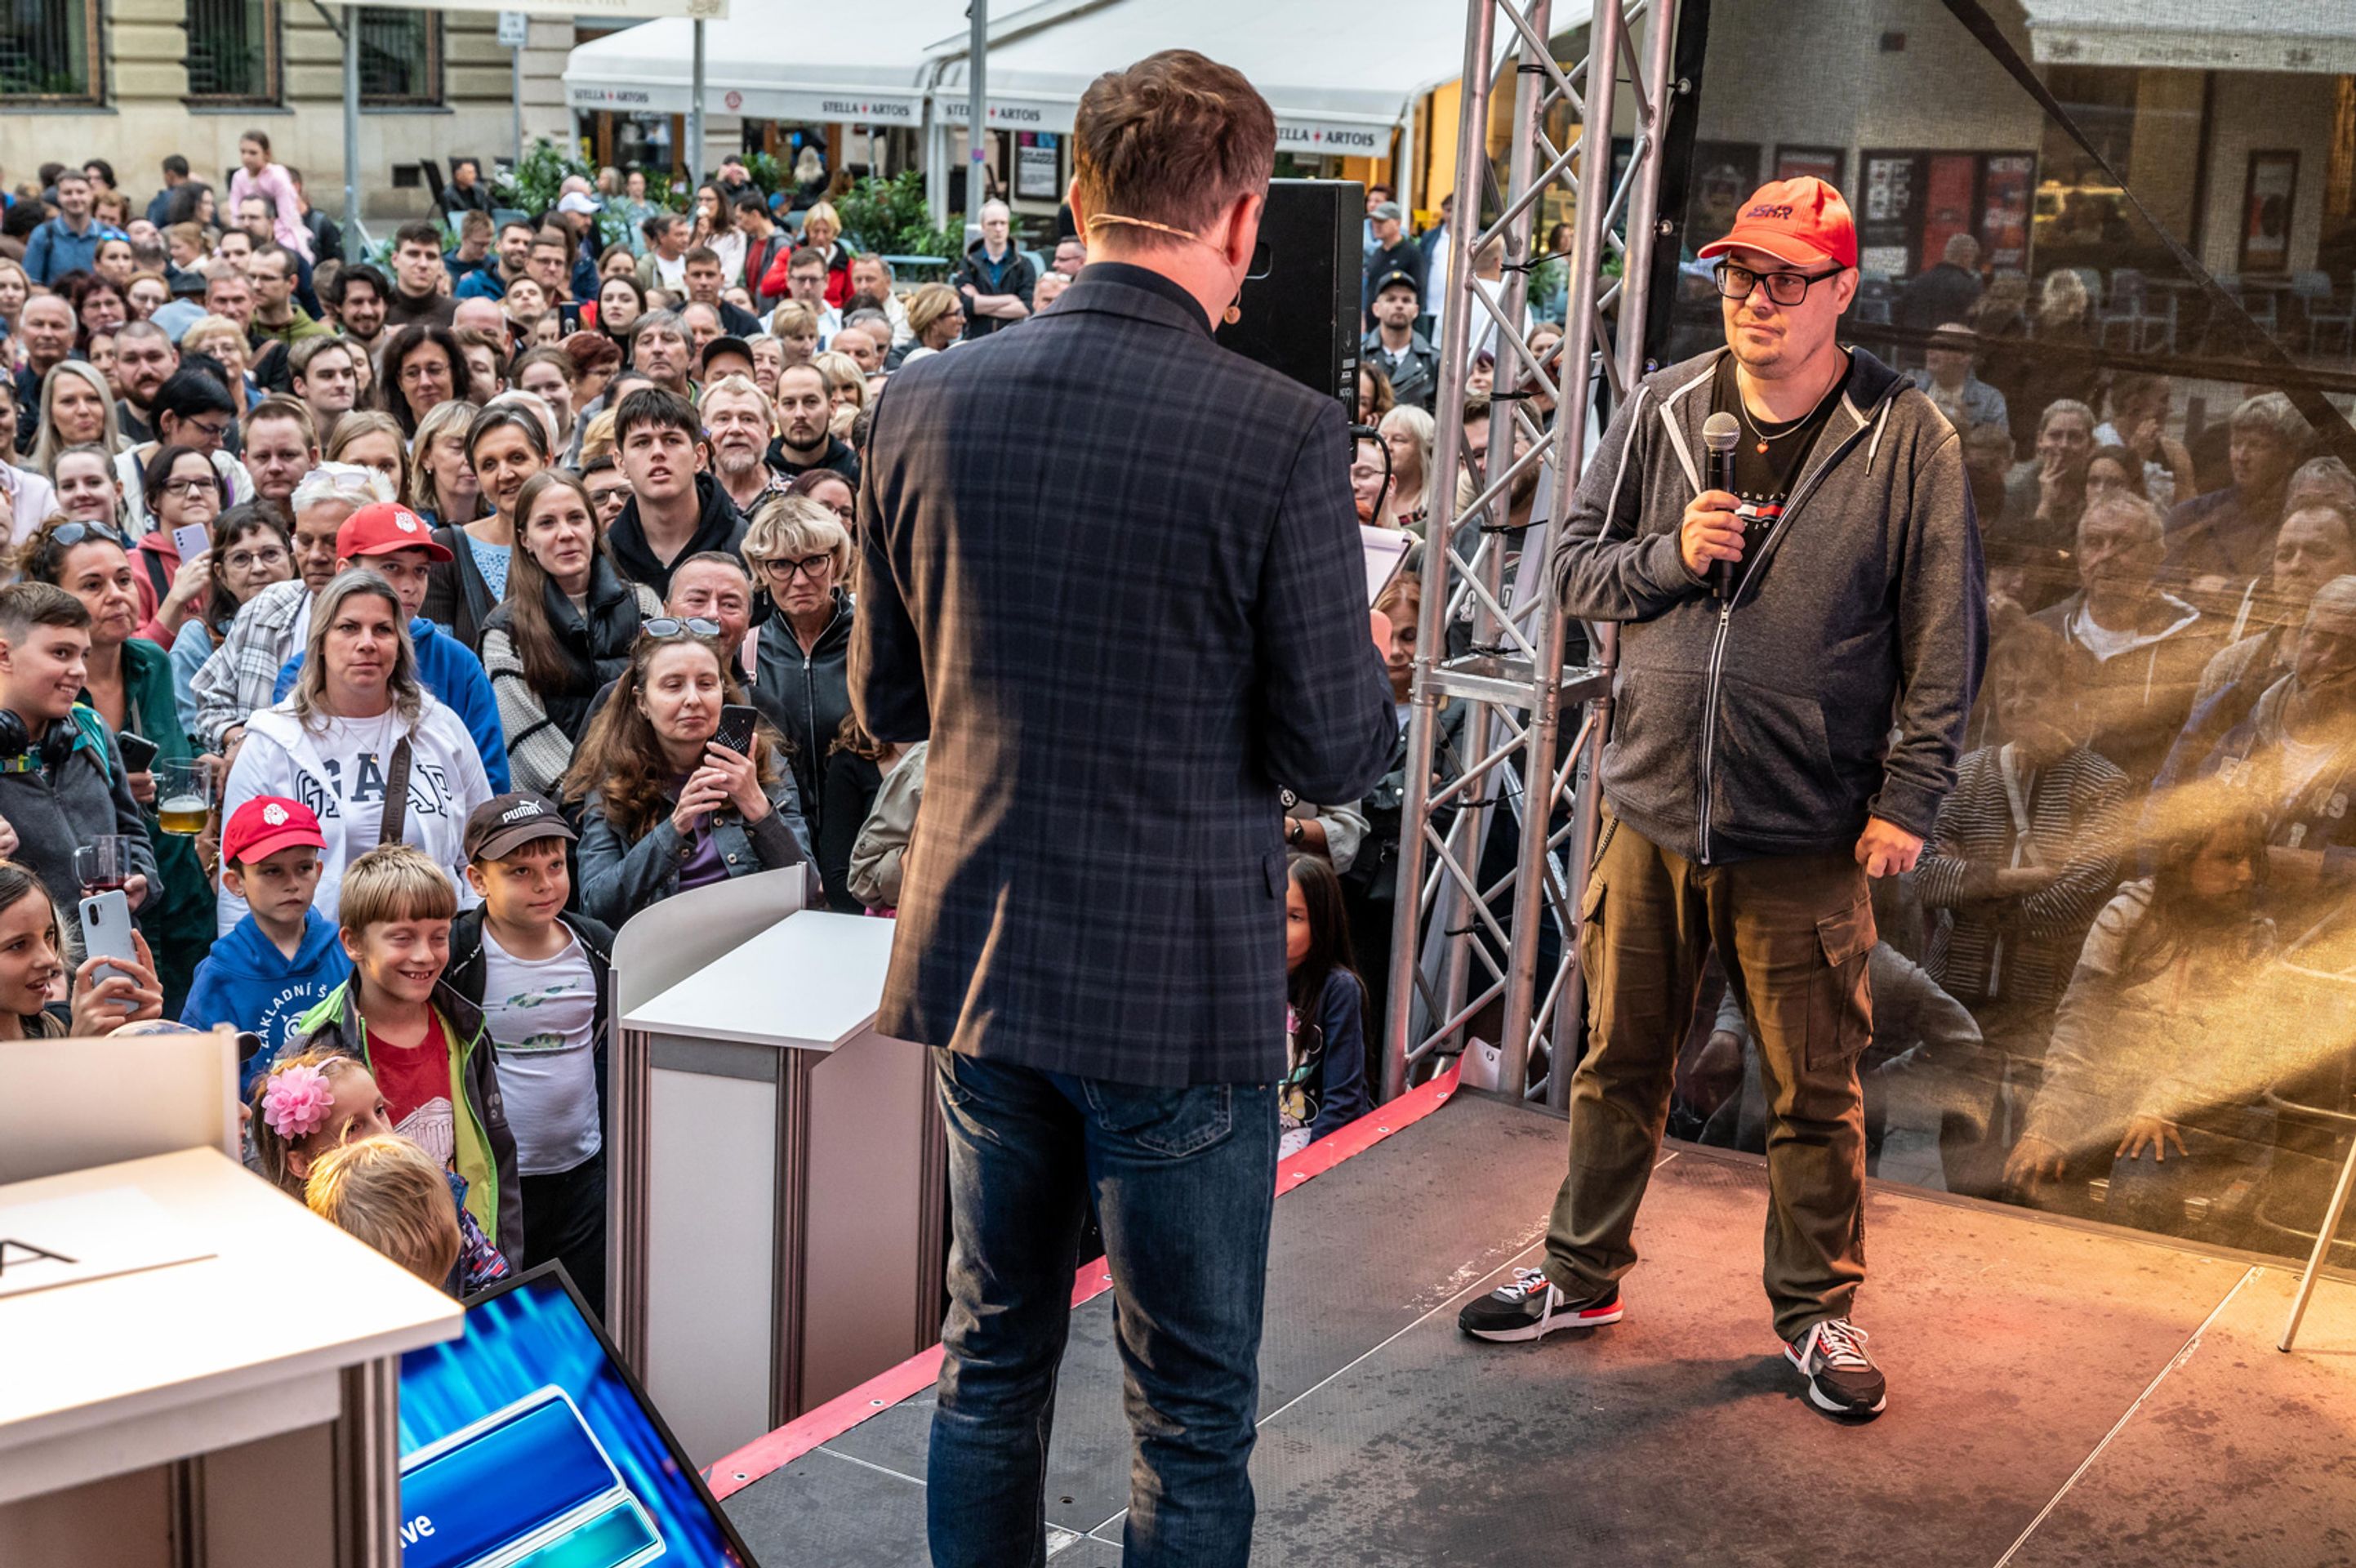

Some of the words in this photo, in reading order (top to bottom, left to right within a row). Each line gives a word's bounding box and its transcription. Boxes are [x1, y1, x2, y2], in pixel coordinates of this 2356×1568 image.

[574, 88, 605, 100] STELLA
[616, 91, 649, 103] ARTOIS
[822, 101, 858, 114] STELLA
[871, 104, 910, 116] ARTOIS
[999, 108, 1041, 121] ARTOIS
[1278, 127, 1309, 141] ELLA
[1325, 131, 1374, 146] ARTOIS
[502, 805, 539, 823] PUMA
[256, 982, 312, 1049] ZÁKLADNÍ
[317, 983, 327, 998] Š
